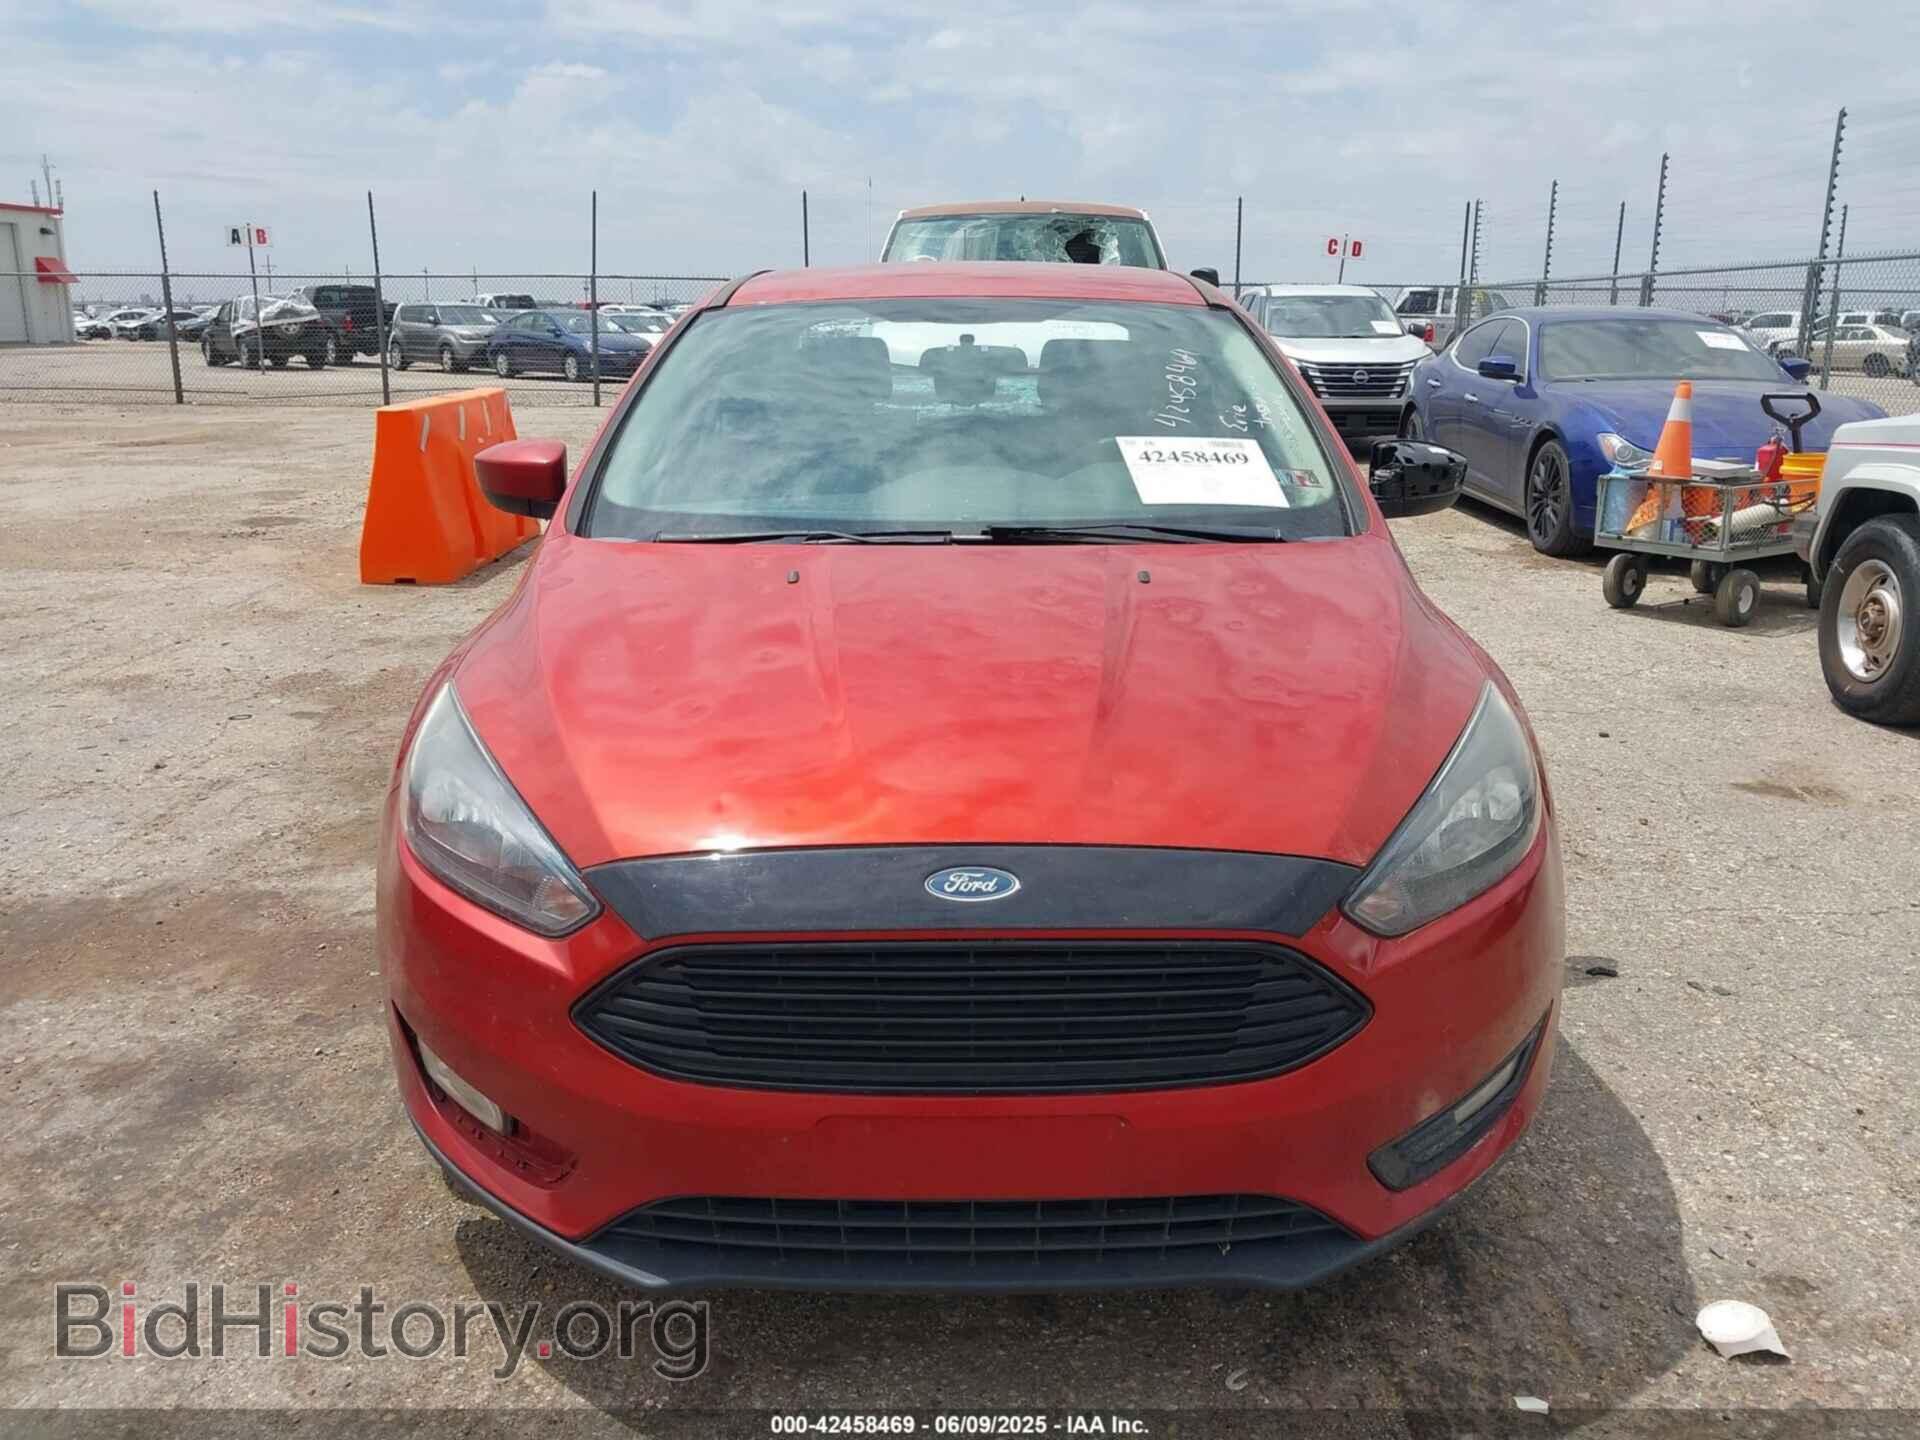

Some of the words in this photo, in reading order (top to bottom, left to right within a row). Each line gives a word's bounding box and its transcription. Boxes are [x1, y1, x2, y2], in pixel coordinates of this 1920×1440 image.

[231, 228, 241, 245] A
[256, 228, 267, 245] B
[1327, 238, 1338, 255] C
[1351, 240, 1362, 257] D
[1139, 450, 1249, 464] 42458469
[943, 872, 998, 892] Ford
